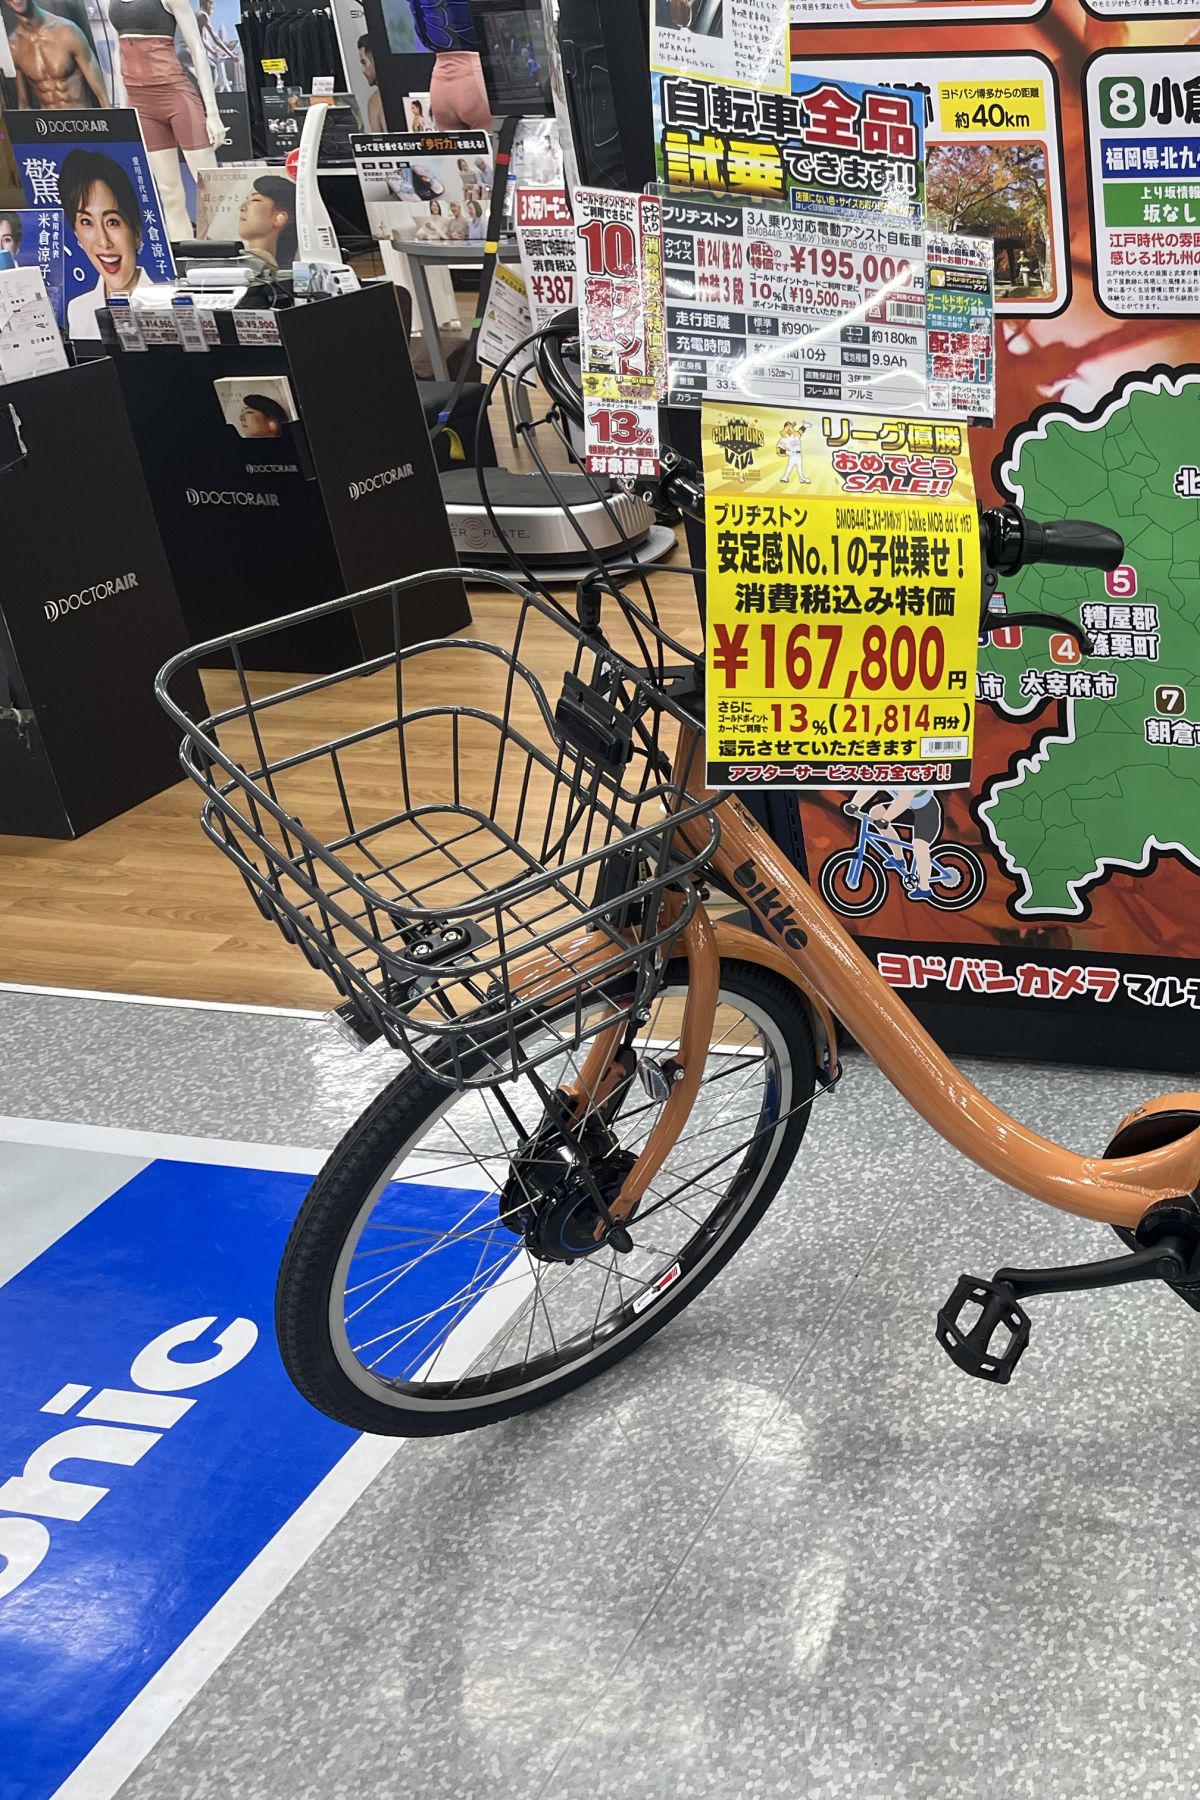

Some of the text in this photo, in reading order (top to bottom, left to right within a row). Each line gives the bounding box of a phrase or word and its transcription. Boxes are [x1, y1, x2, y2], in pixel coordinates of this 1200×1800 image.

[941, 87, 1040, 101] ヨドバシ博多からの距離
[1109, 82, 1138, 122] 8
[48, 119, 109, 133] DOCTORAIR
[954, 103, 1031, 129] 約40km
[662, 205, 740, 237] ブリヂストン
[1143, 203, 1197, 223] 坂なし
[521, 229, 541, 238] POWER
[746, 211, 922, 249] 3人乗り対応電動アシスト自転車
[664, 236, 692, 250] タイヤ
[664, 247, 693, 262] サイズ
[926, 293, 984, 306] ゴールドポイント
[675, 310, 731, 330] 走行距離
[676, 335, 731, 354] 充電時間
[871, 329, 918, 347] 約180km
[872, 352, 908, 368] 9.9Ah
[675, 393, 699, 403] カラー
[847, 388, 874, 401] アルミ
[588, 409, 654, 445] 13%
[711, 425, 765, 447] CHAMPIONS
[821, 416, 962, 455] リーグ優勝
[832, 450, 957, 478] おめでとう
[359, 463, 414, 495] DOCTORAIR
[842, 474, 952, 497] SALE!!
[200, 490, 280, 507] DOCTORAIR
[714, 504, 808, 528] ブリヂストン
[927, 512, 944, 532] MOB
[717, 531, 965, 579] 安定感No.1の子供乗せ!
[1112, 571, 1131, 592] 5
[59, 572, 138, 614] DOCTORAIR
[735, 583, 956, 616] 消費税込み特価
[1083, 605, 1158, 631] 糟屋郡
[1056, 639, 1075, 659] 4
[1087, 633, 1158, 659] 篠栗町
[1022, 672, 1118, 700] 太宰府市
[718, 701, 753, 713] さらに
[1162, 690, 1179, 711] 7
[718, 714, 768, 723] ゴールドポイント
[718, 724, 768, 734] カードご利用で
[719, 740, 917, 757] 還元させていただきます
[728, 765, 951, 782] アフターサービスも万全です!!
[878, 953, 1120, 1003] ヨドバシカメラ
